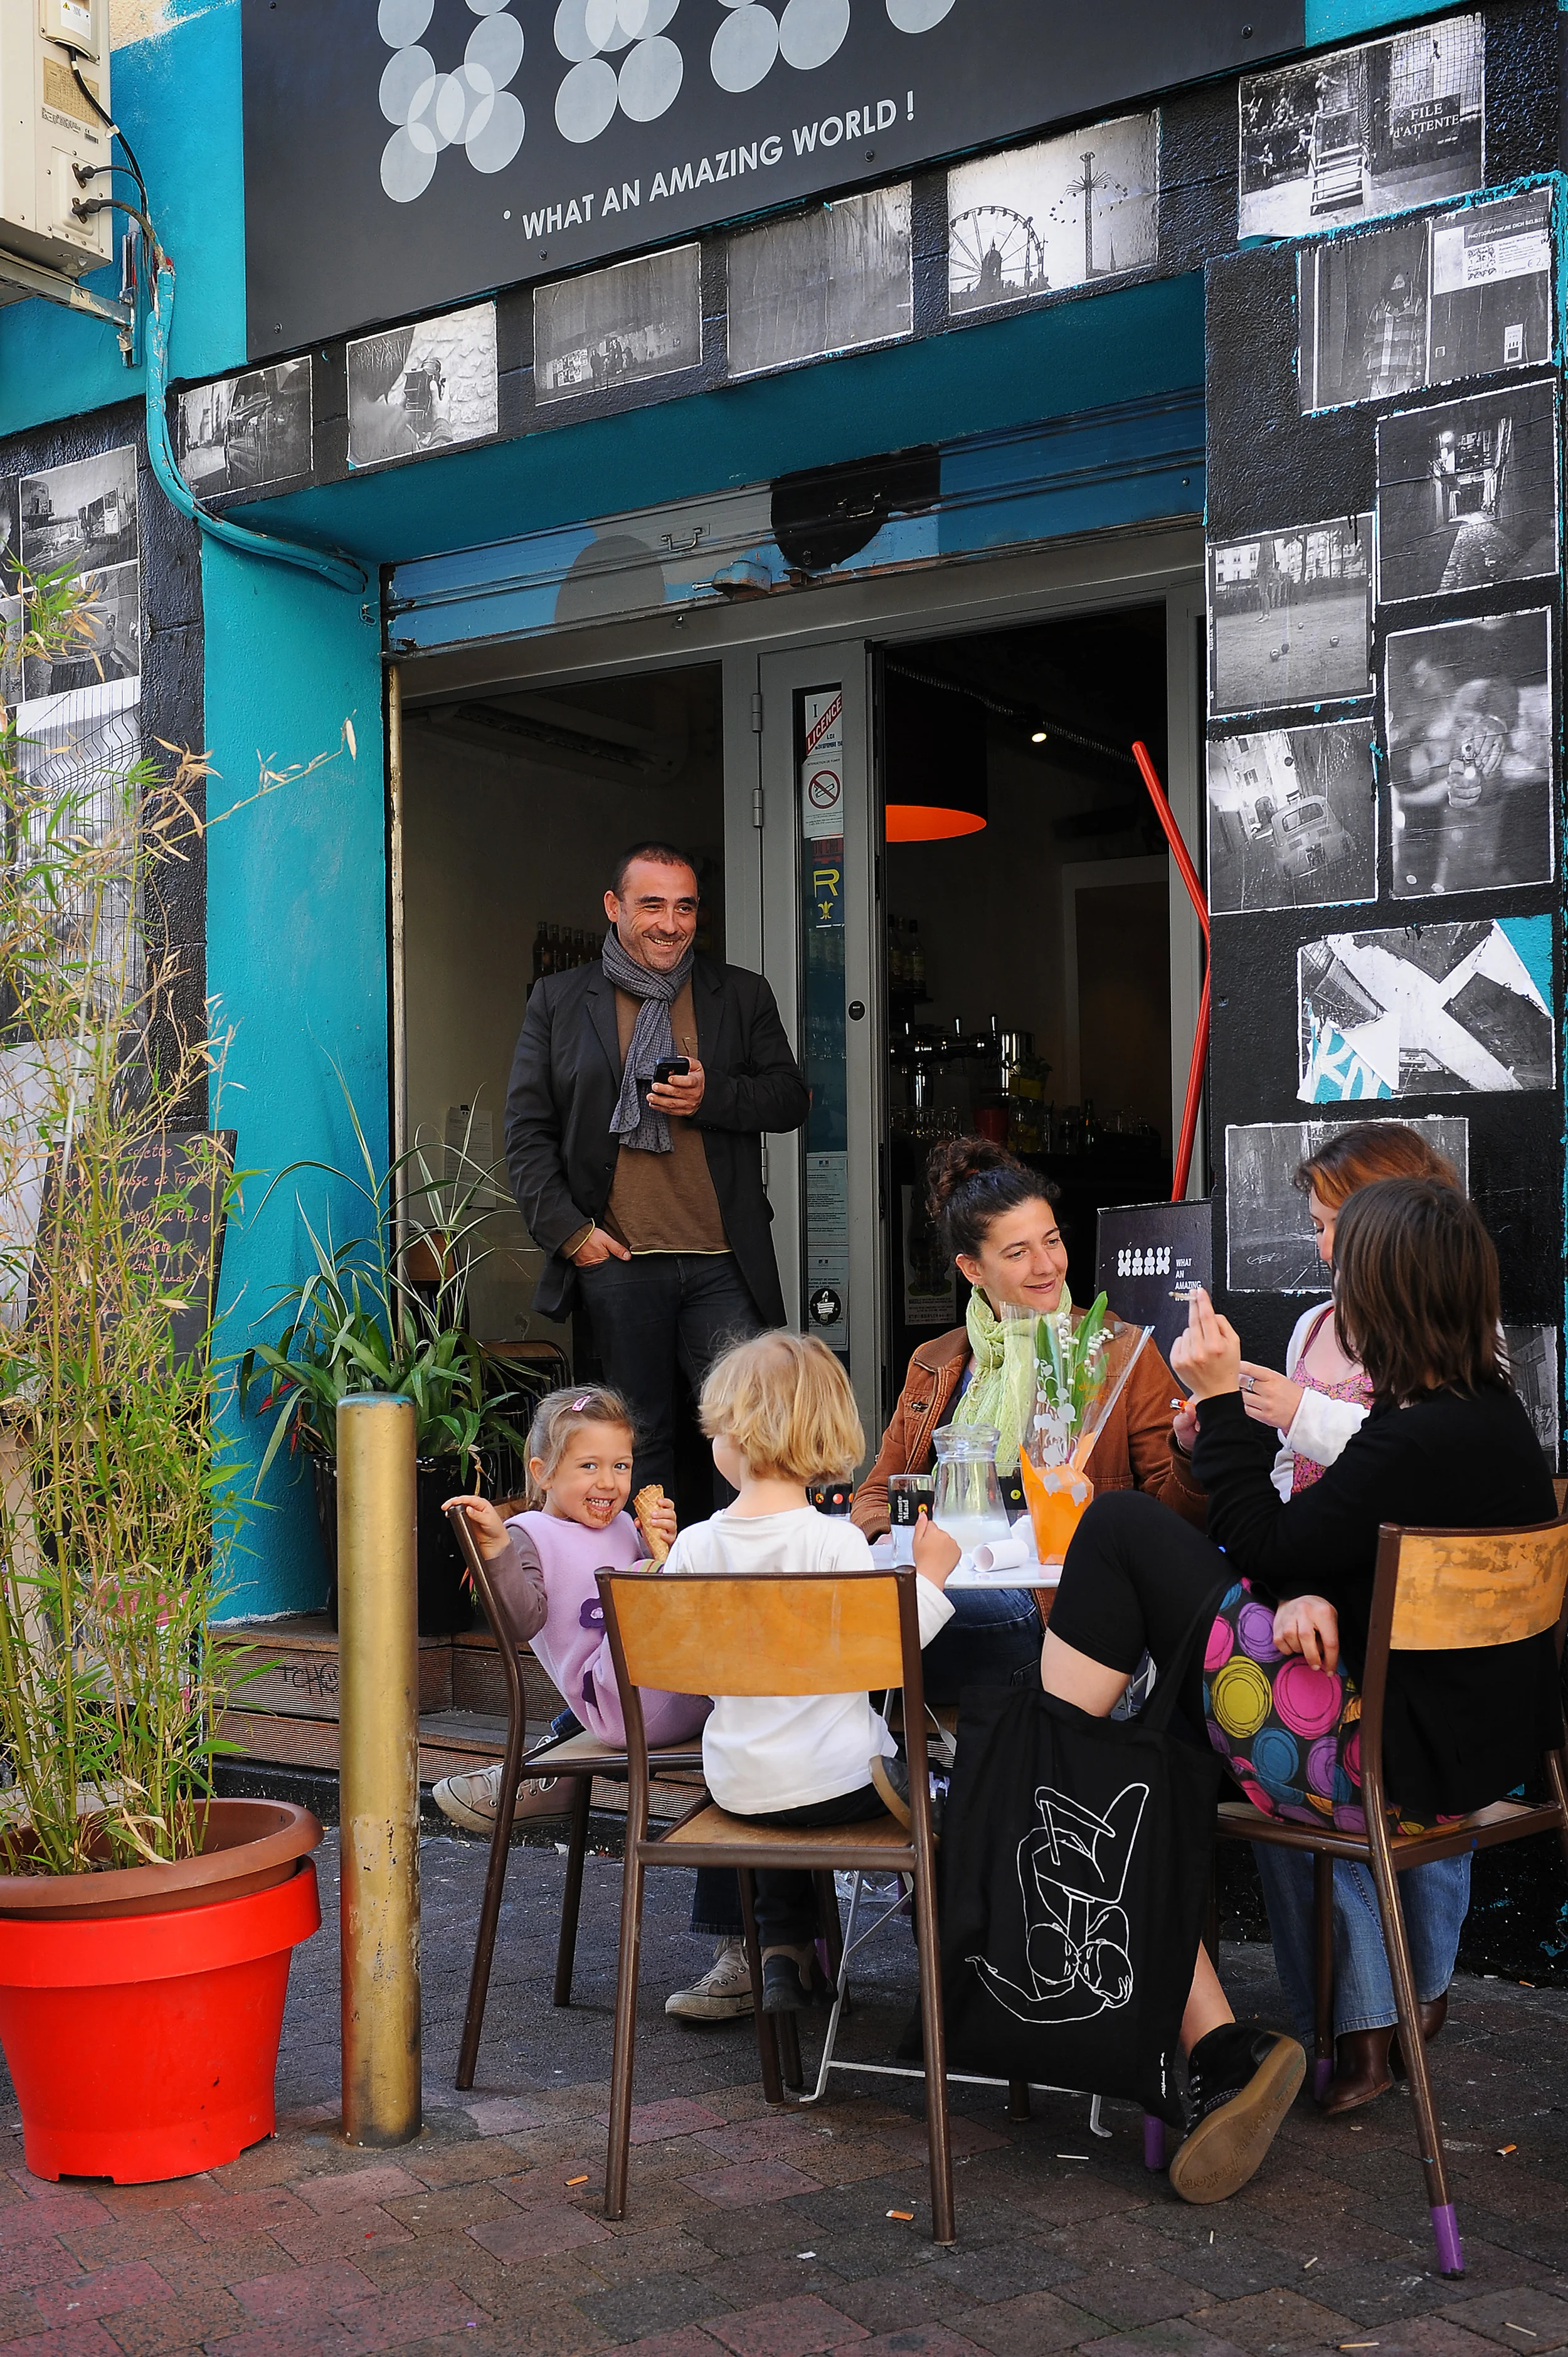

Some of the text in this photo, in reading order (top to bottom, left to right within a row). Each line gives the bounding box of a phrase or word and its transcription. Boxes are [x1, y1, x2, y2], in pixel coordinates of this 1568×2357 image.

[1411, 103, 1443, 120] FILE
[1393, 114, 1459, 138] d'ATTENTE
[522, 194, 595, 240] WHAT
[601, 179, 640, 216] AN
[649, 136, 783, 202] AMAZING
[792, 98, 897, 156] WORLD
[807, 695, 842, 751] LICENCE
[813, 868, 840, 898] R
[1175, 1258, 1192, 1267] WHAT
[1175, 1270, 1185, 1279] AN
[1174, 1280, 1202, 1290] AMAZING
